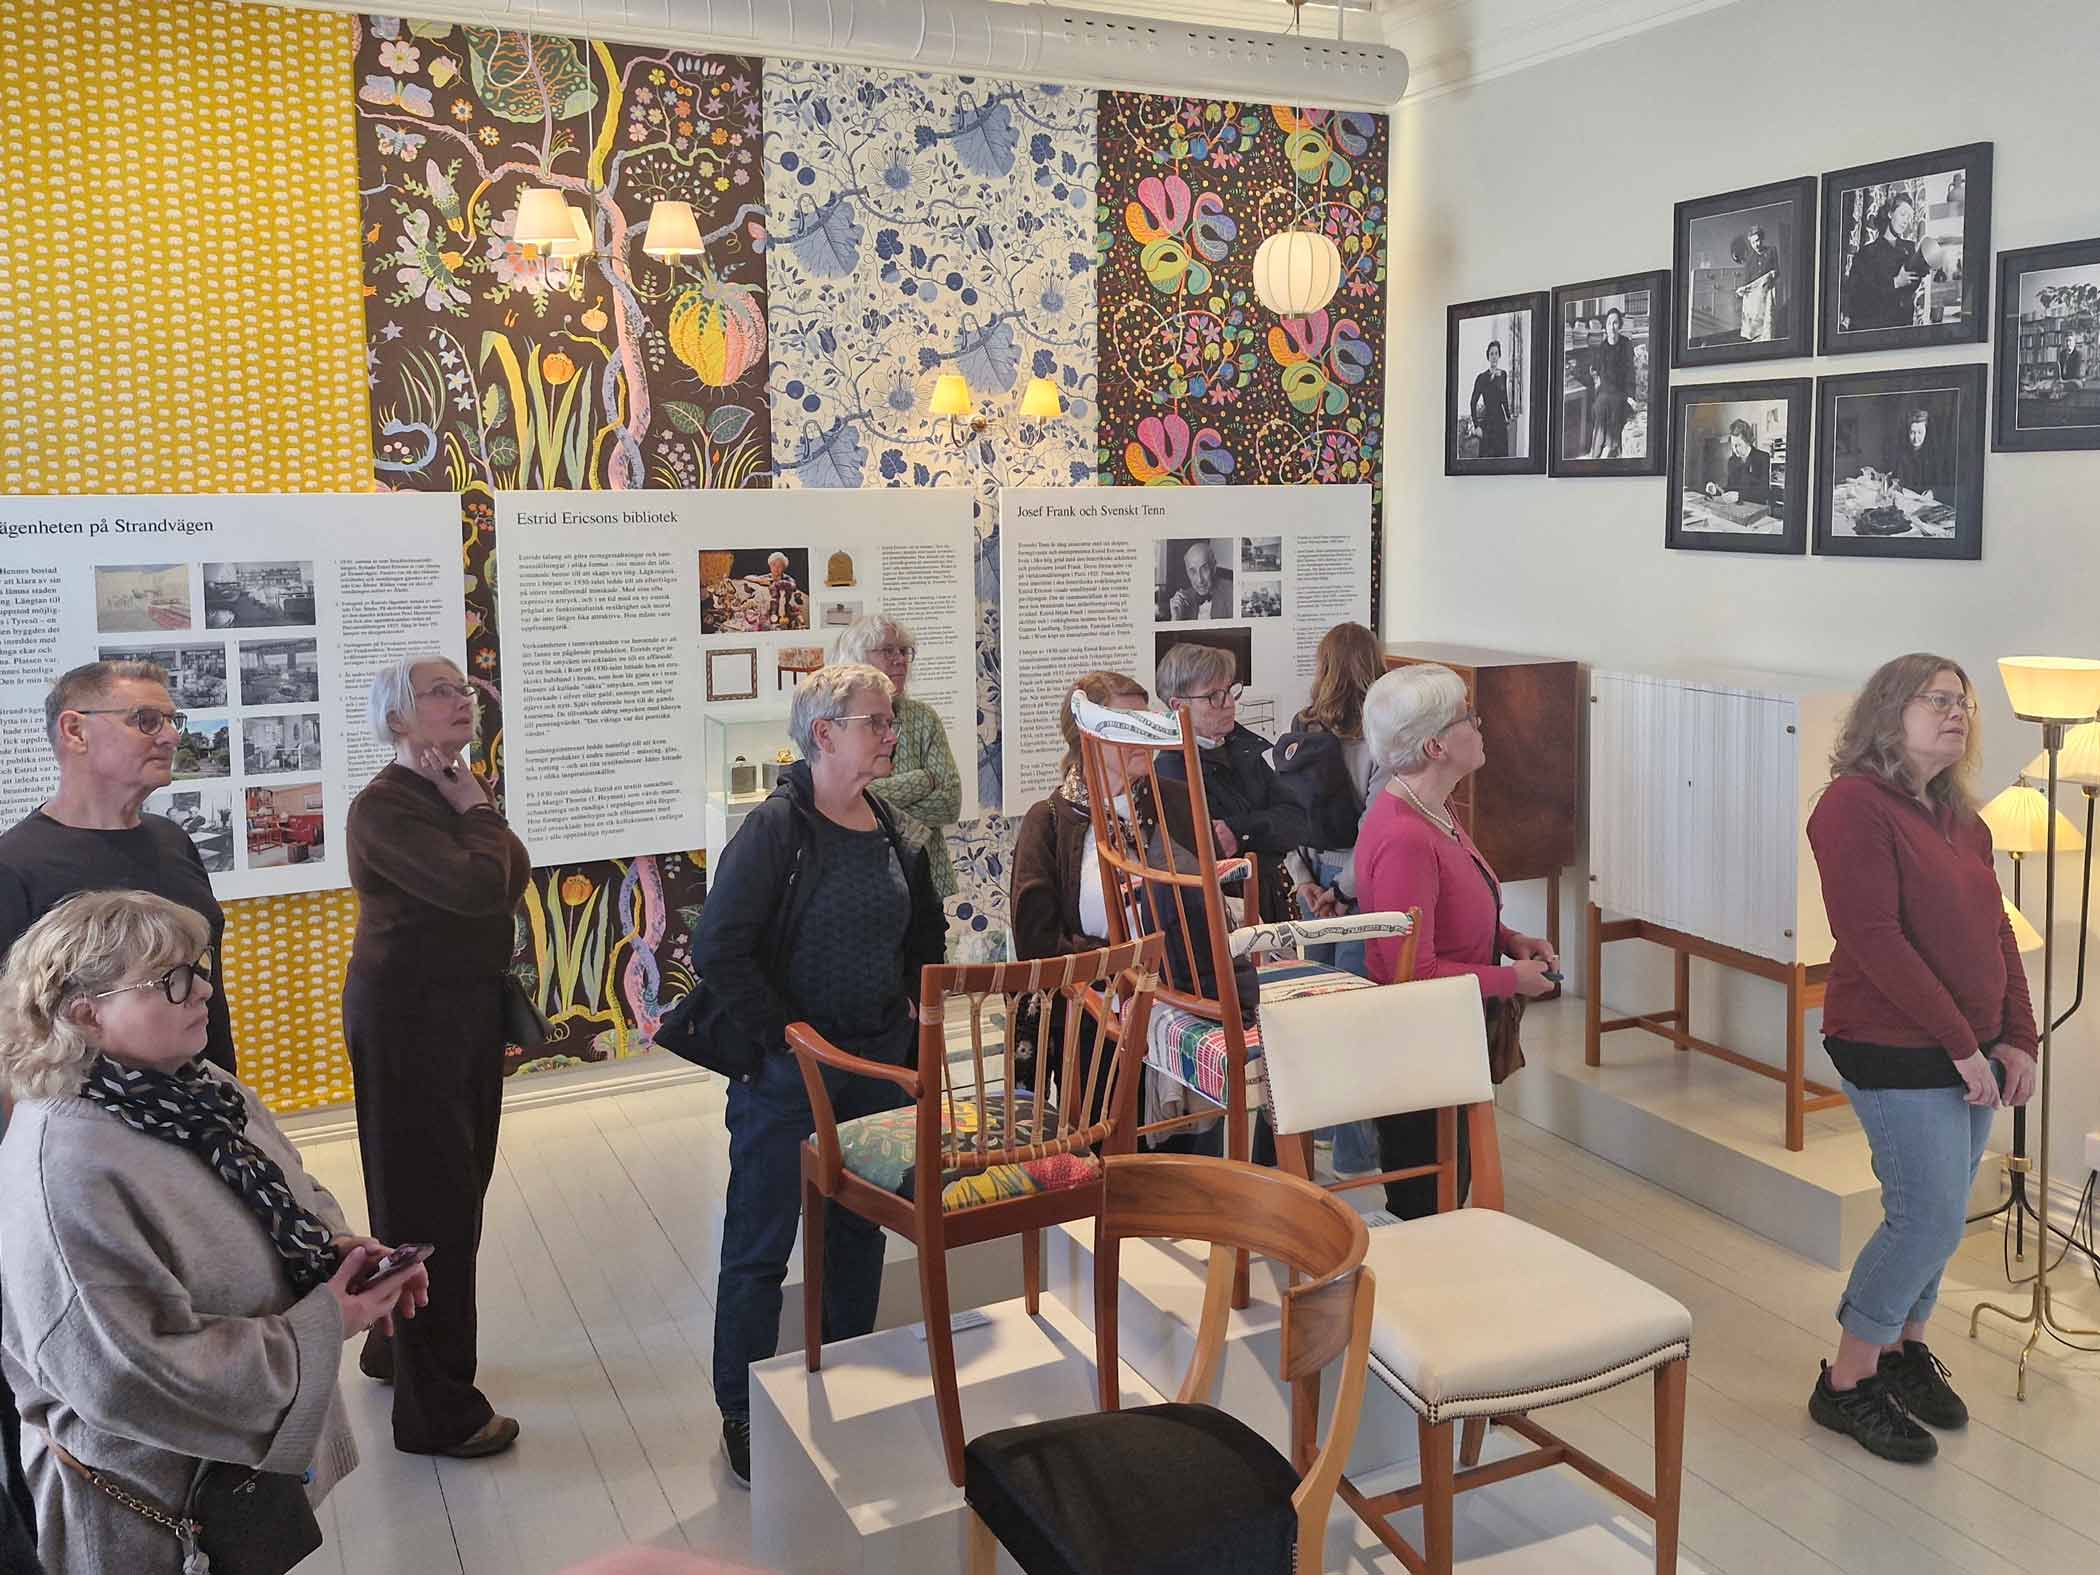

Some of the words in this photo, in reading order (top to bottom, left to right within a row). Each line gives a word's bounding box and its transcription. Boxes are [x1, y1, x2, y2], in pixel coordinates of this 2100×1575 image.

[517, 512, 556, 524] Estrid
[563, 512, 618, 524] Ericsons
[623, 511, 678, 523] bibliotek
[1018, 506, 1042, 517] Josef
[1046, 506, 1076, 517] Frank
[1080, 506, 1097, 516] och
[1101, 505, 1138, 516] Svenskt
[1142, 505, 1165, 515] Tenn
[90, 519, 108, 536] på
[115, 519, 214, 534] Strandvägen
